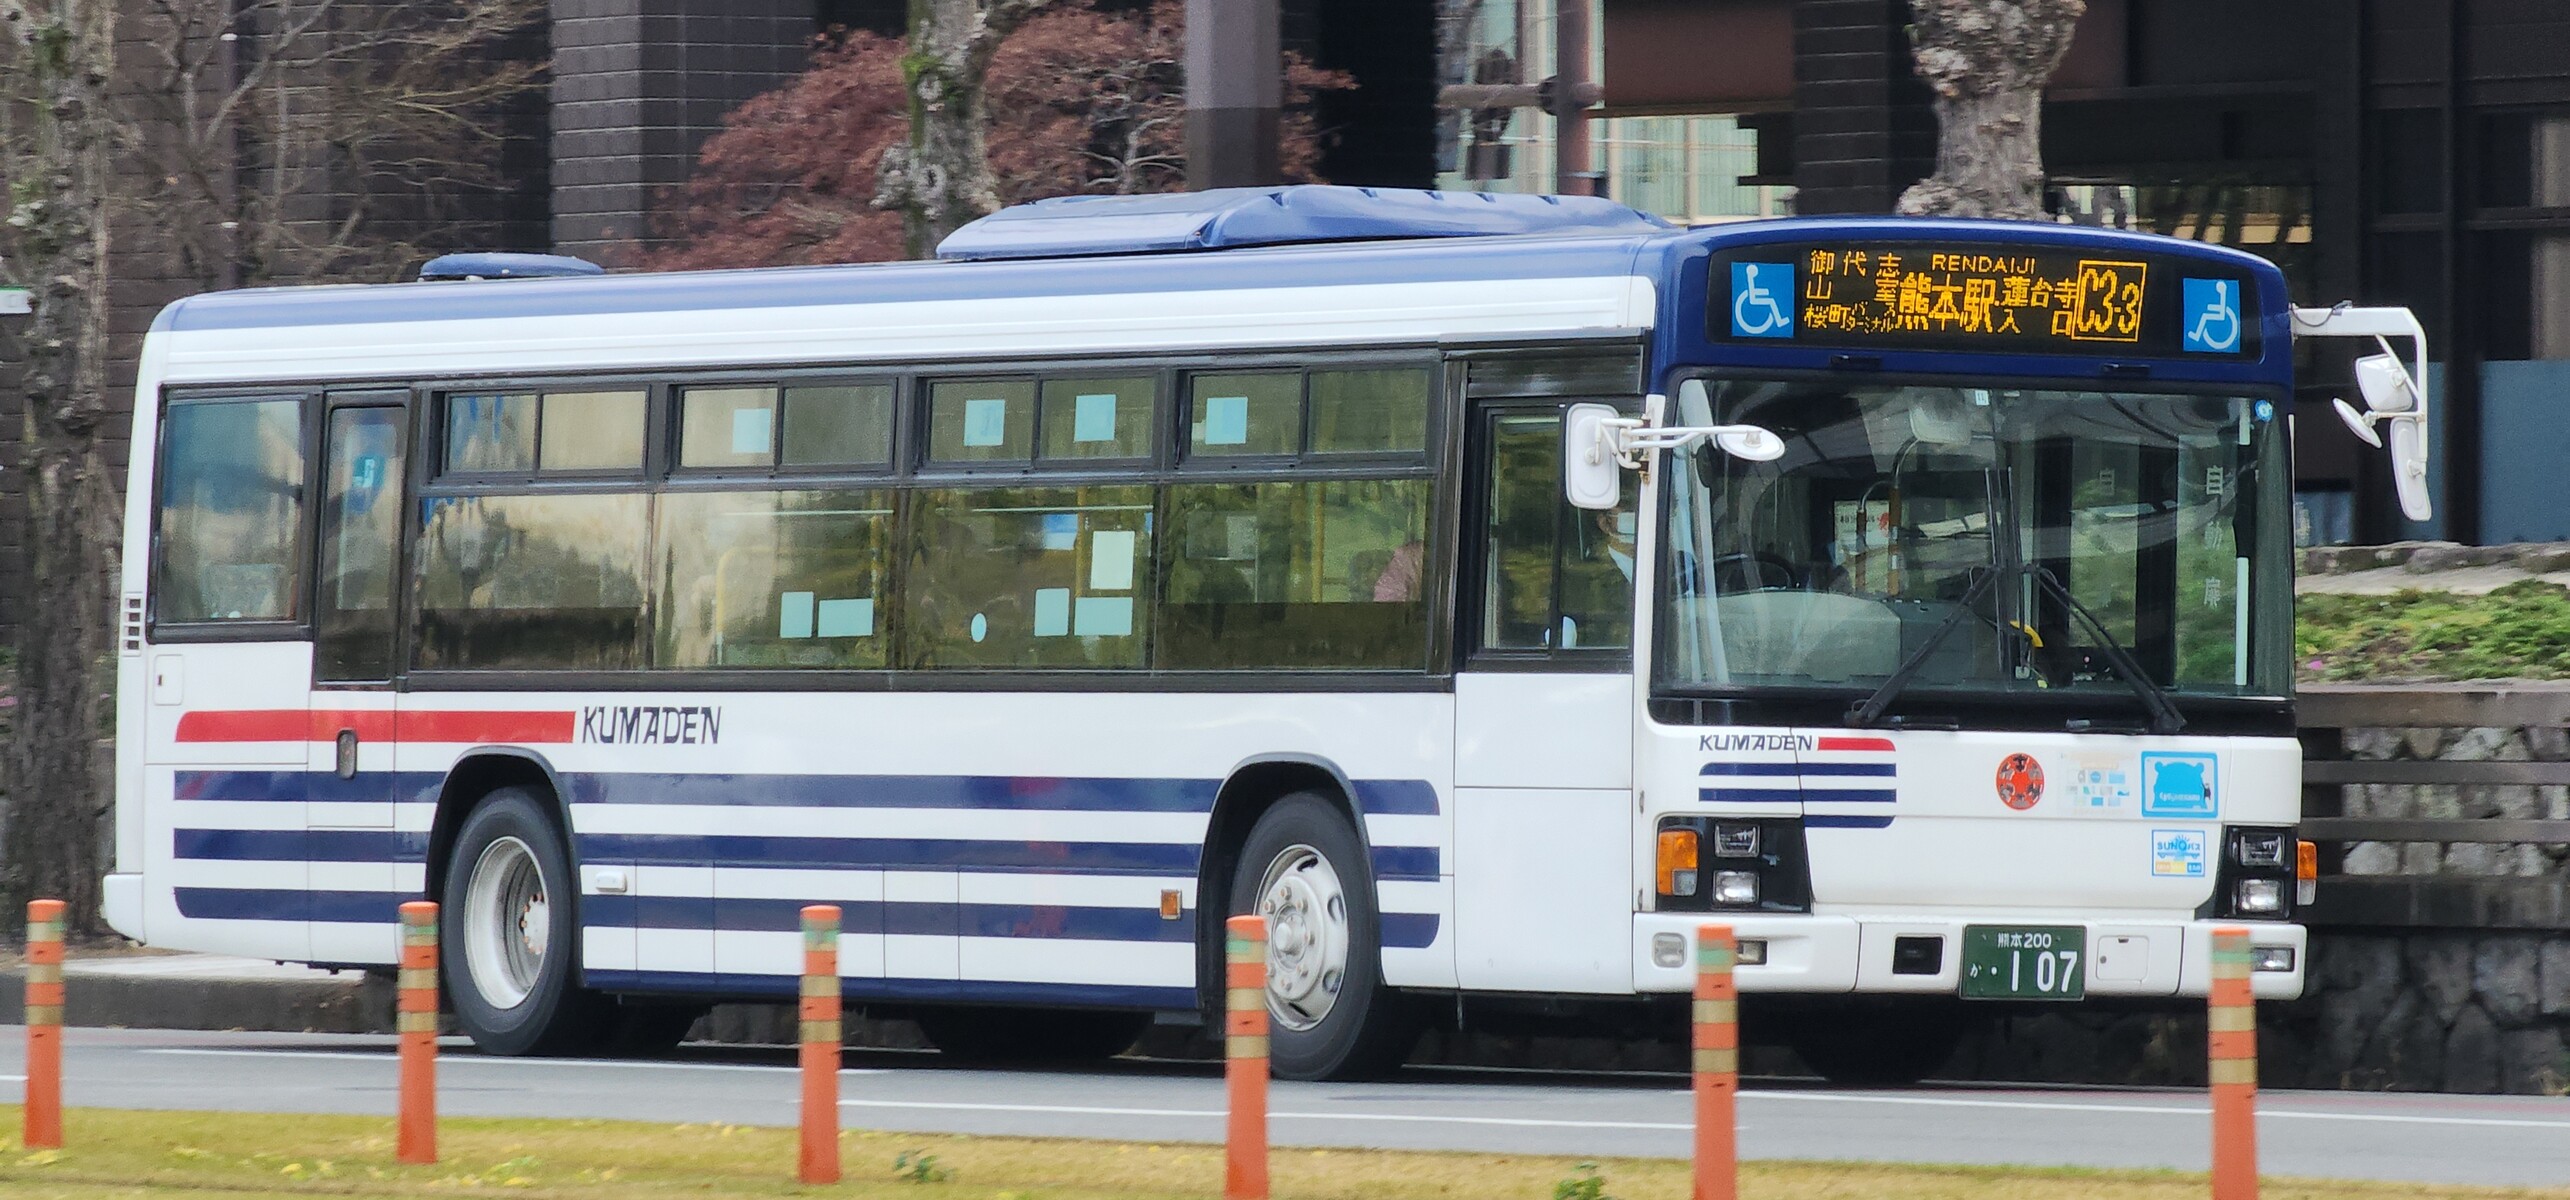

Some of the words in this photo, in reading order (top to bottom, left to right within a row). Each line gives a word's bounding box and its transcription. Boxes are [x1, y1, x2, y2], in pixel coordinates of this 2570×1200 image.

[1810, 250, 1902, 278] 御代志
[1932, 254, 2036, 274] RENDAIJI
[2077, 268, 2140, 334] C3-3
[582, 706, 721, 744] KUMADEN
[1699, 734, 1813, 751] KUMADEN
